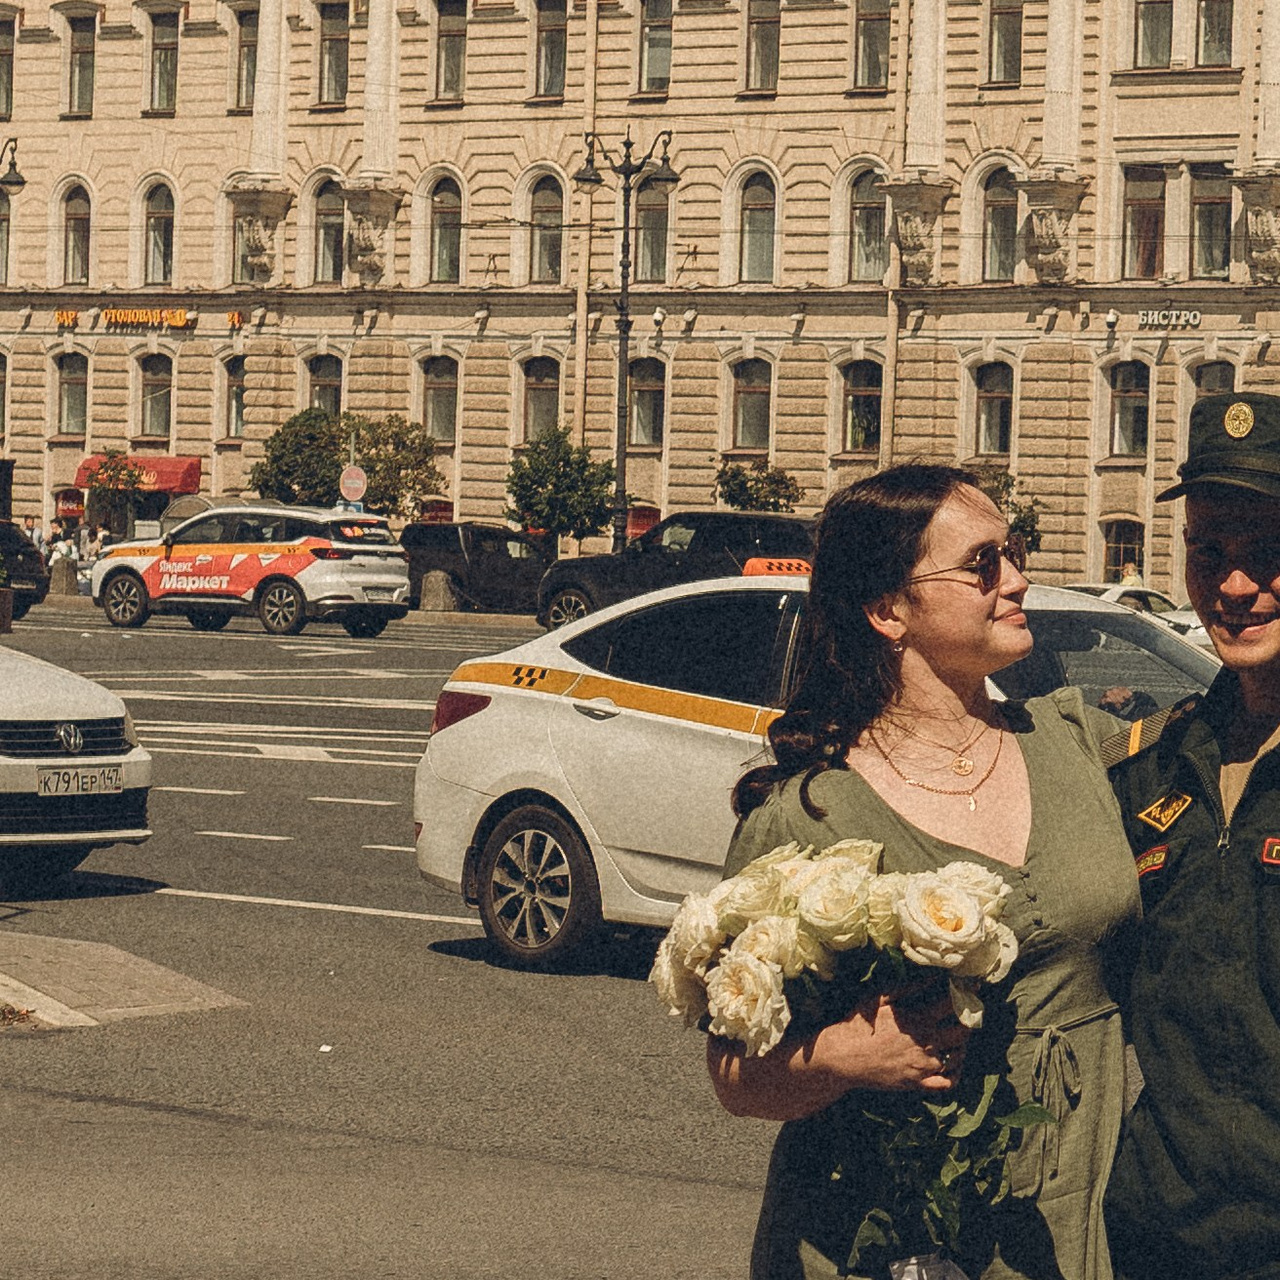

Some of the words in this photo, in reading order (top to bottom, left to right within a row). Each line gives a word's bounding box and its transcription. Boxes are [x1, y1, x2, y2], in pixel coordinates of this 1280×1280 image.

[54, 311, 76, 324] БАР
[102, 309, 160, 323] СТОЛОВАЯ
[1138, 310, 1201, 325] БИСТРО
[159, 561, 193, 573] Яндекс
[159, 574, 230, 590] Маркет
